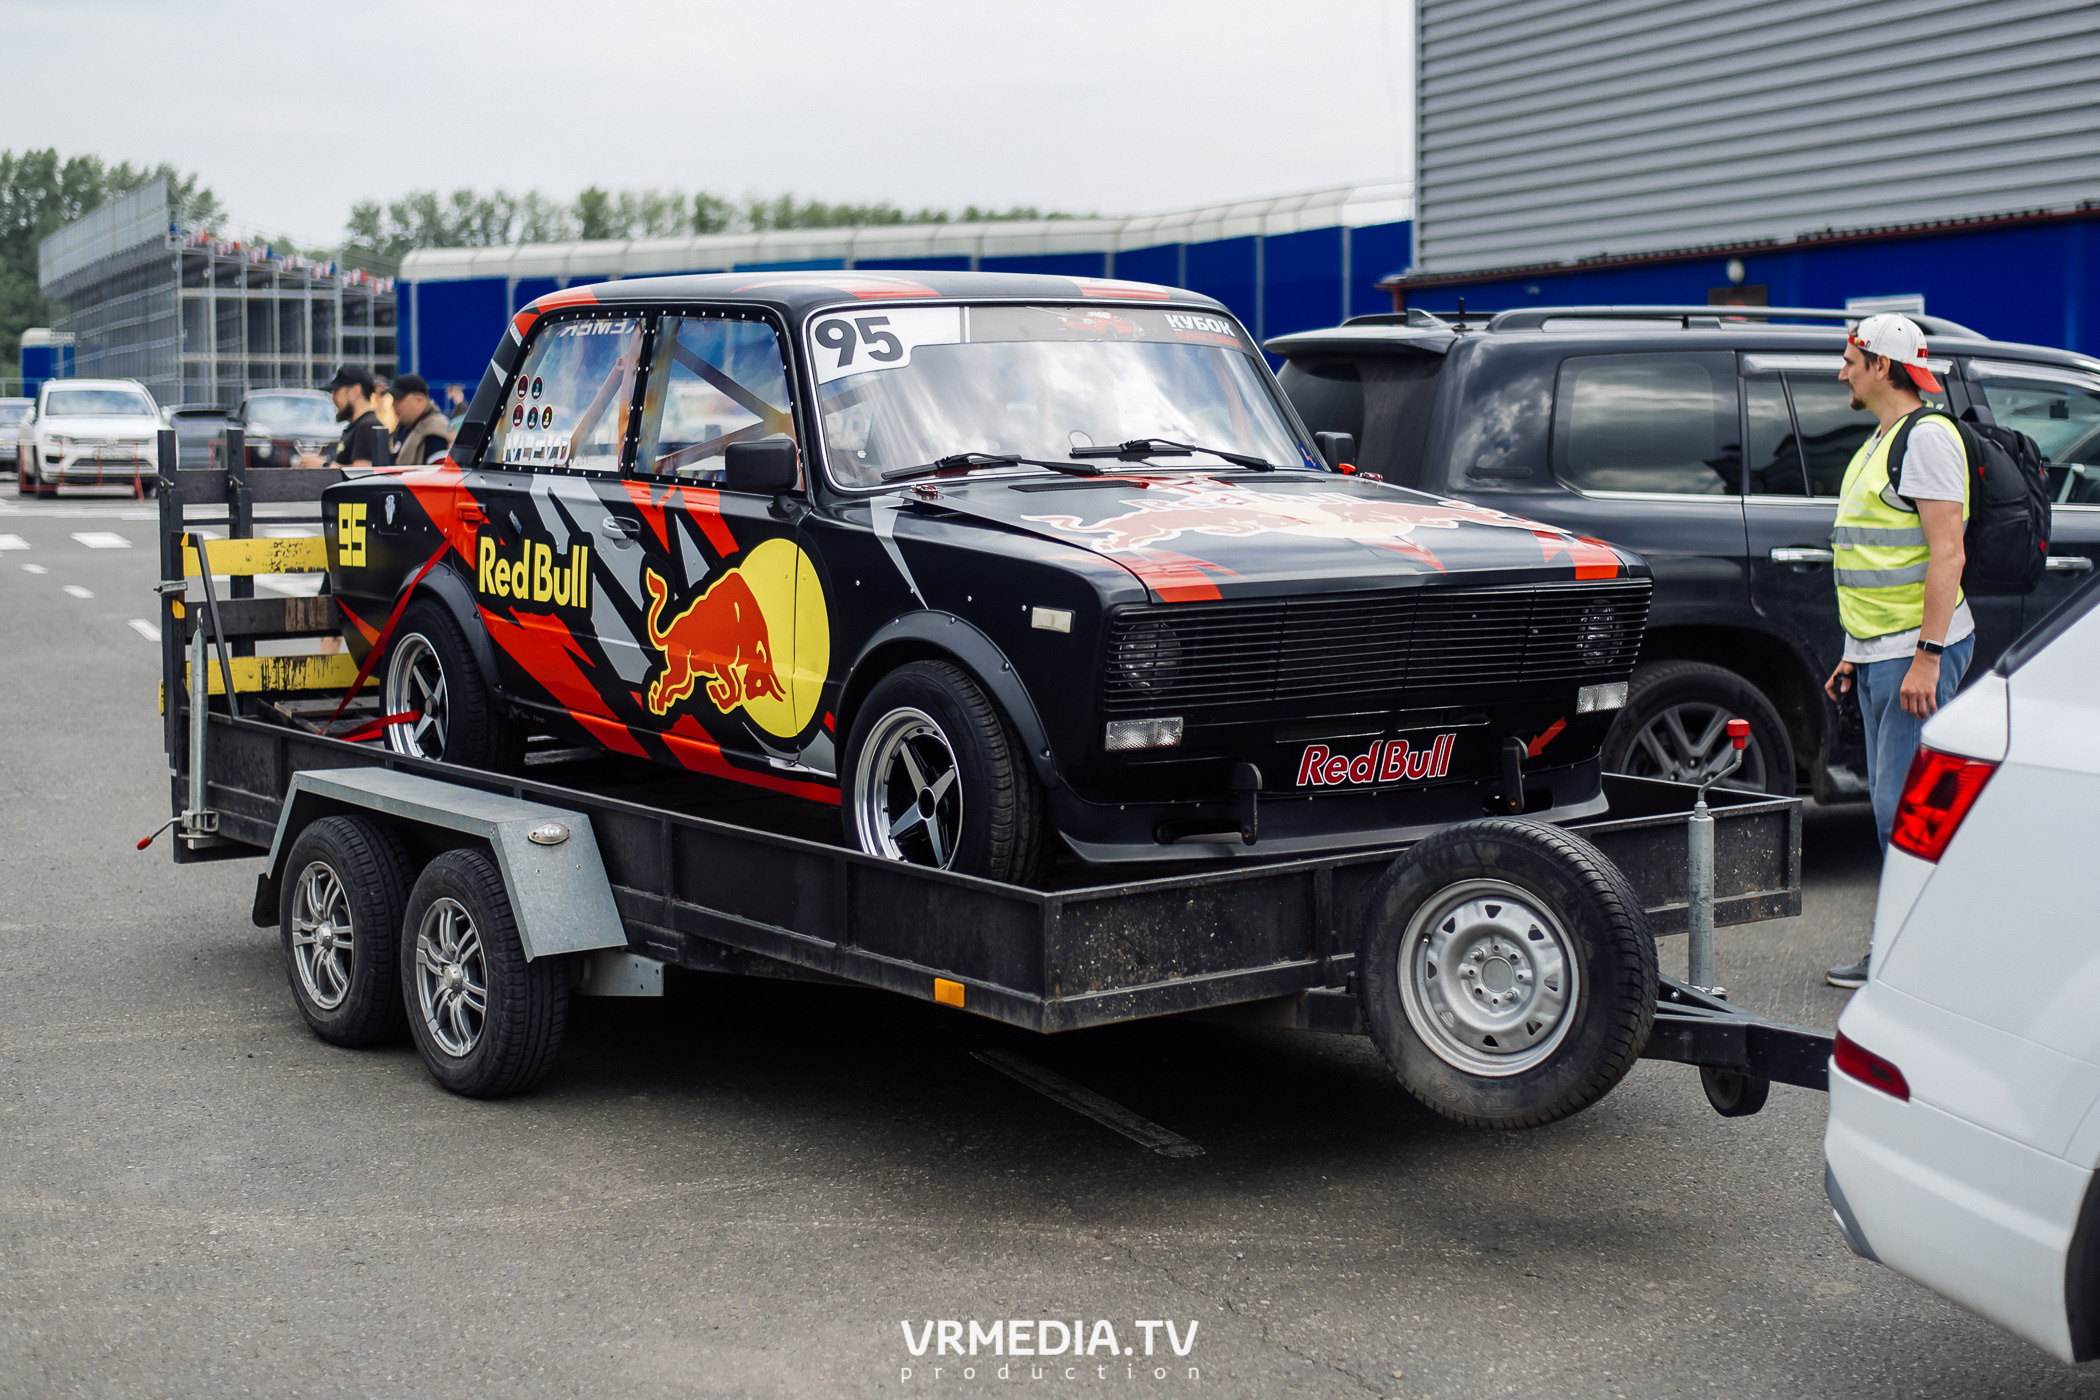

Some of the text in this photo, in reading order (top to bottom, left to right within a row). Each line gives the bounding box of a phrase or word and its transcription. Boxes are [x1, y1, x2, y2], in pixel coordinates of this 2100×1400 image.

[814, 316, 904, 369] 95
[1164, 313, 1236, 338] КУБОК
[338, 503, 367, 567] 95
[480, 536, 588, 608] Red Bull
[1296, 733, 1457, 786] Red Bull
